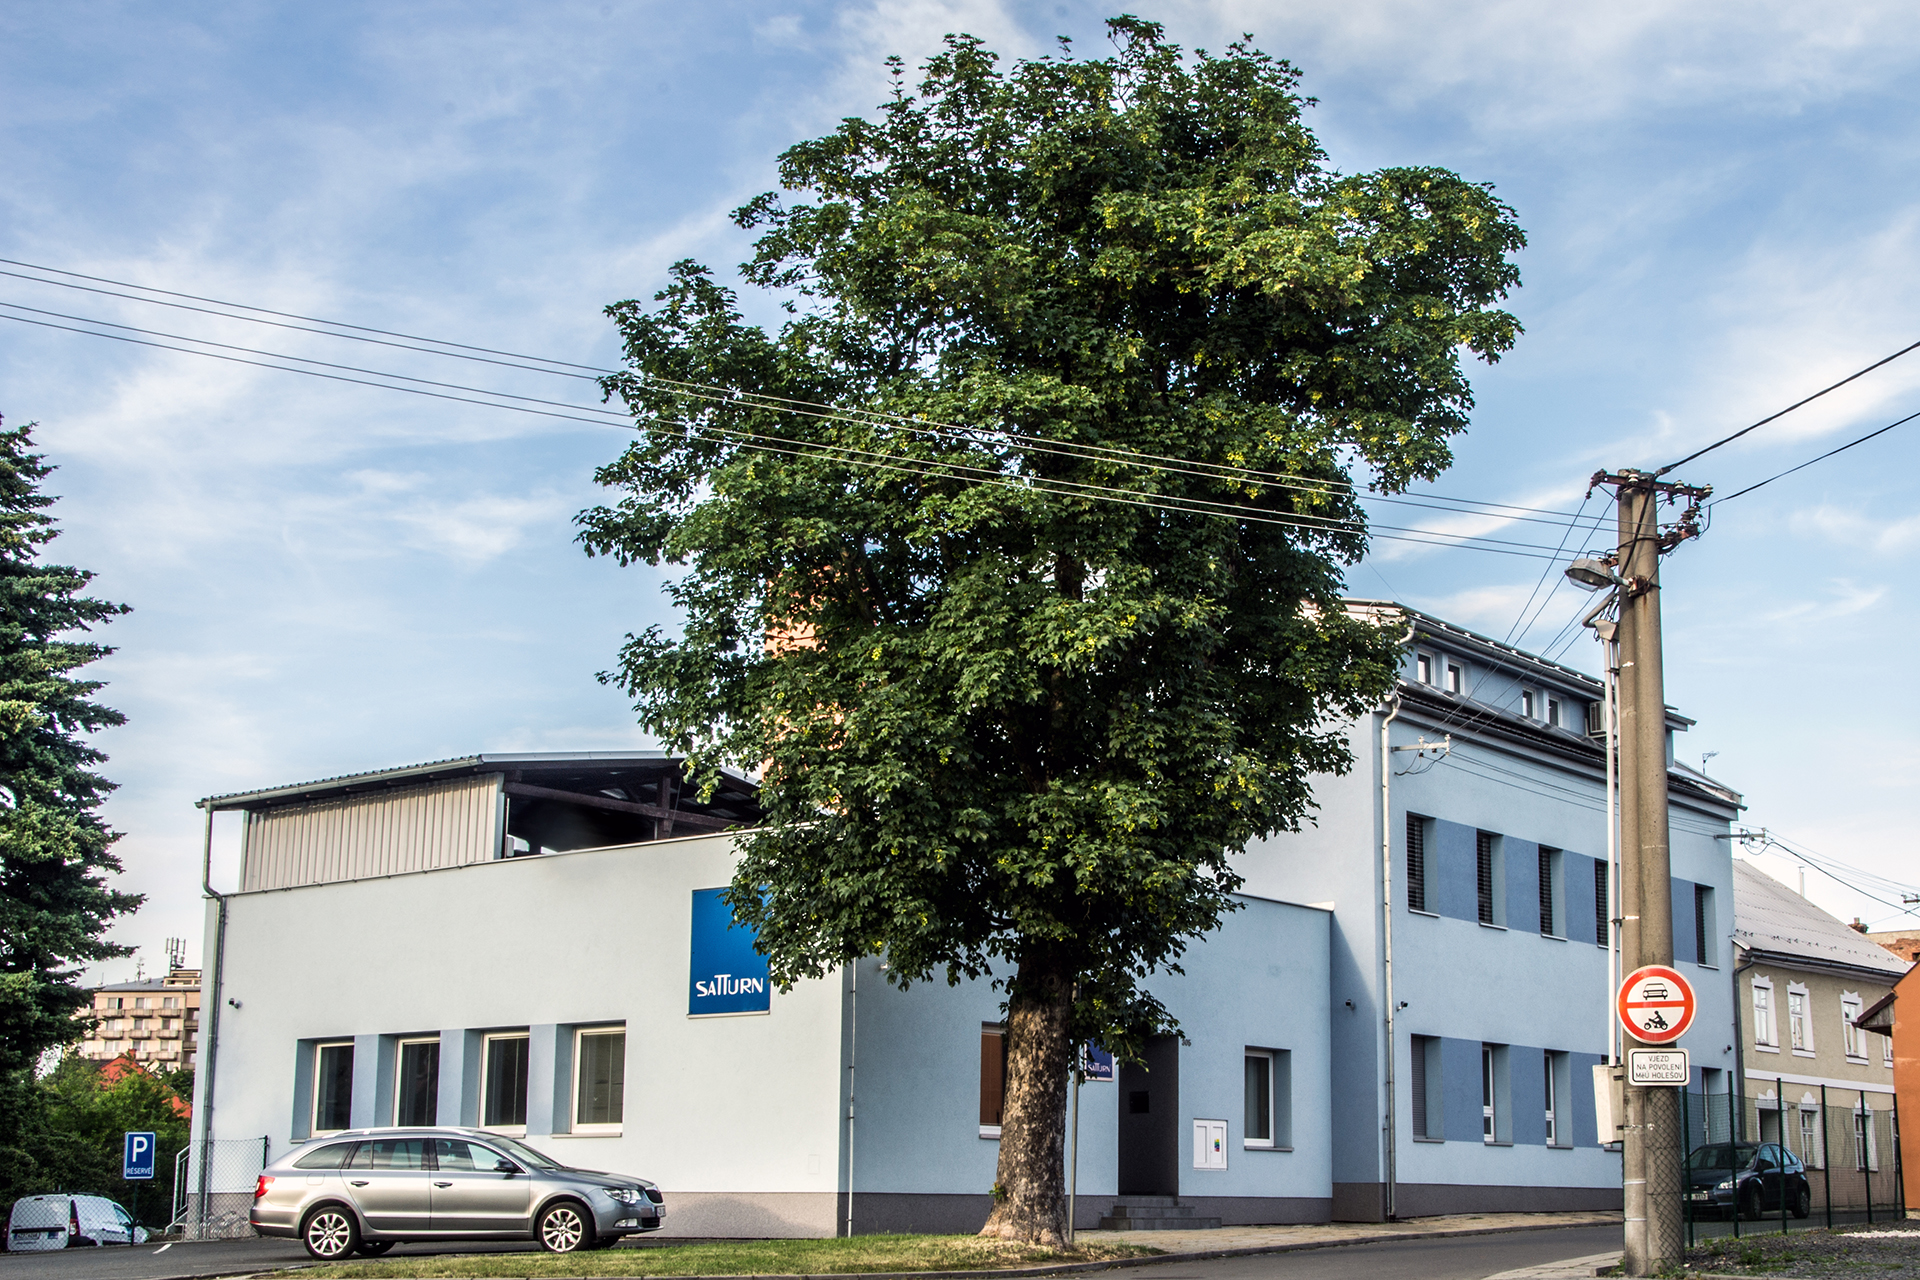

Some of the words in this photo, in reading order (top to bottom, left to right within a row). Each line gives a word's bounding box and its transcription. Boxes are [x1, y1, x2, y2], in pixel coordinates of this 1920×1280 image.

[696, 974, 763, 997] SATTURN
[1649, 1062, 1682, 1070] POVOLENÍ
[1652, 1071, 1683, 1079] HOLEŠOV
[132, 1136, 148, 1162] P
